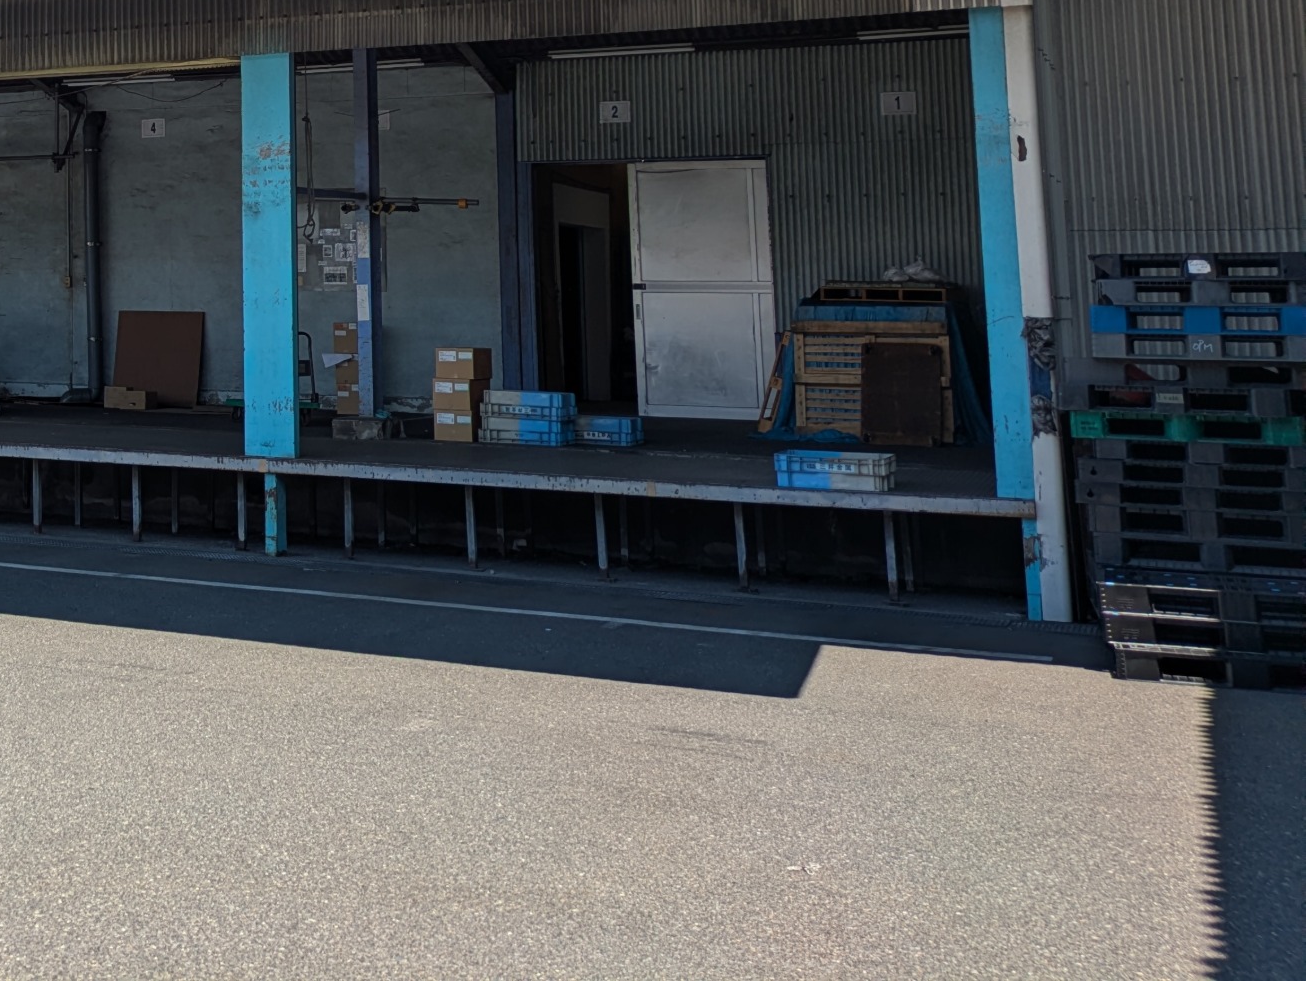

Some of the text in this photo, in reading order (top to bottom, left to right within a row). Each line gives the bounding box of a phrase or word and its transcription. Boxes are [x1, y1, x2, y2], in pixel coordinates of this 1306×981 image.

[894, 95, 901, 110] 1
[611, 105, 619, 119] 2
[150, 122, 157, 134] 4
